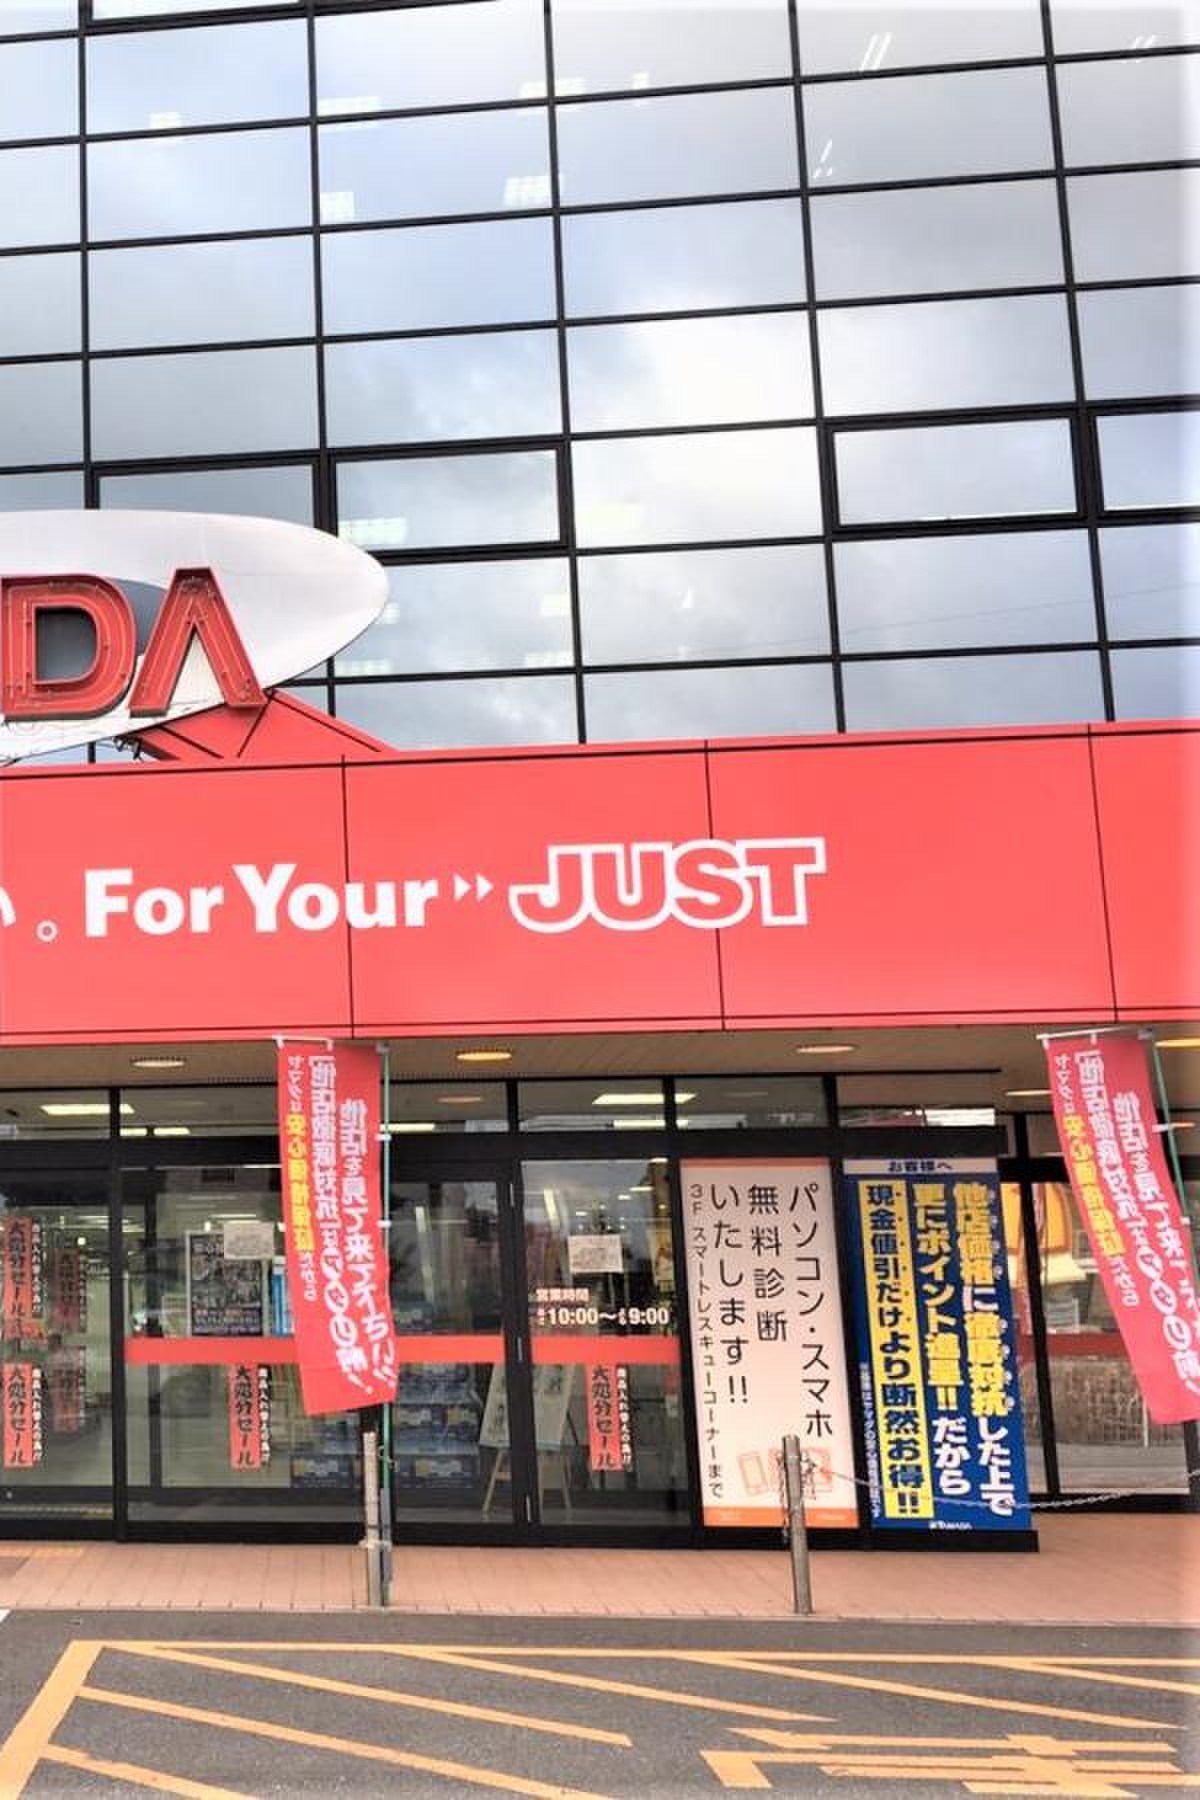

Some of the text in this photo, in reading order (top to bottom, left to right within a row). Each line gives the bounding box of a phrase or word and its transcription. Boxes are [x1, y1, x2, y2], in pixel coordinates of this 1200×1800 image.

[84, 837, 826, 938] For Your JUST
[888, 1161, 953, 1173] お客様へ
[748, 1185, 787, 1342] 無料診断
[790, 1183, 833, 1438] パソコン・スマホ
